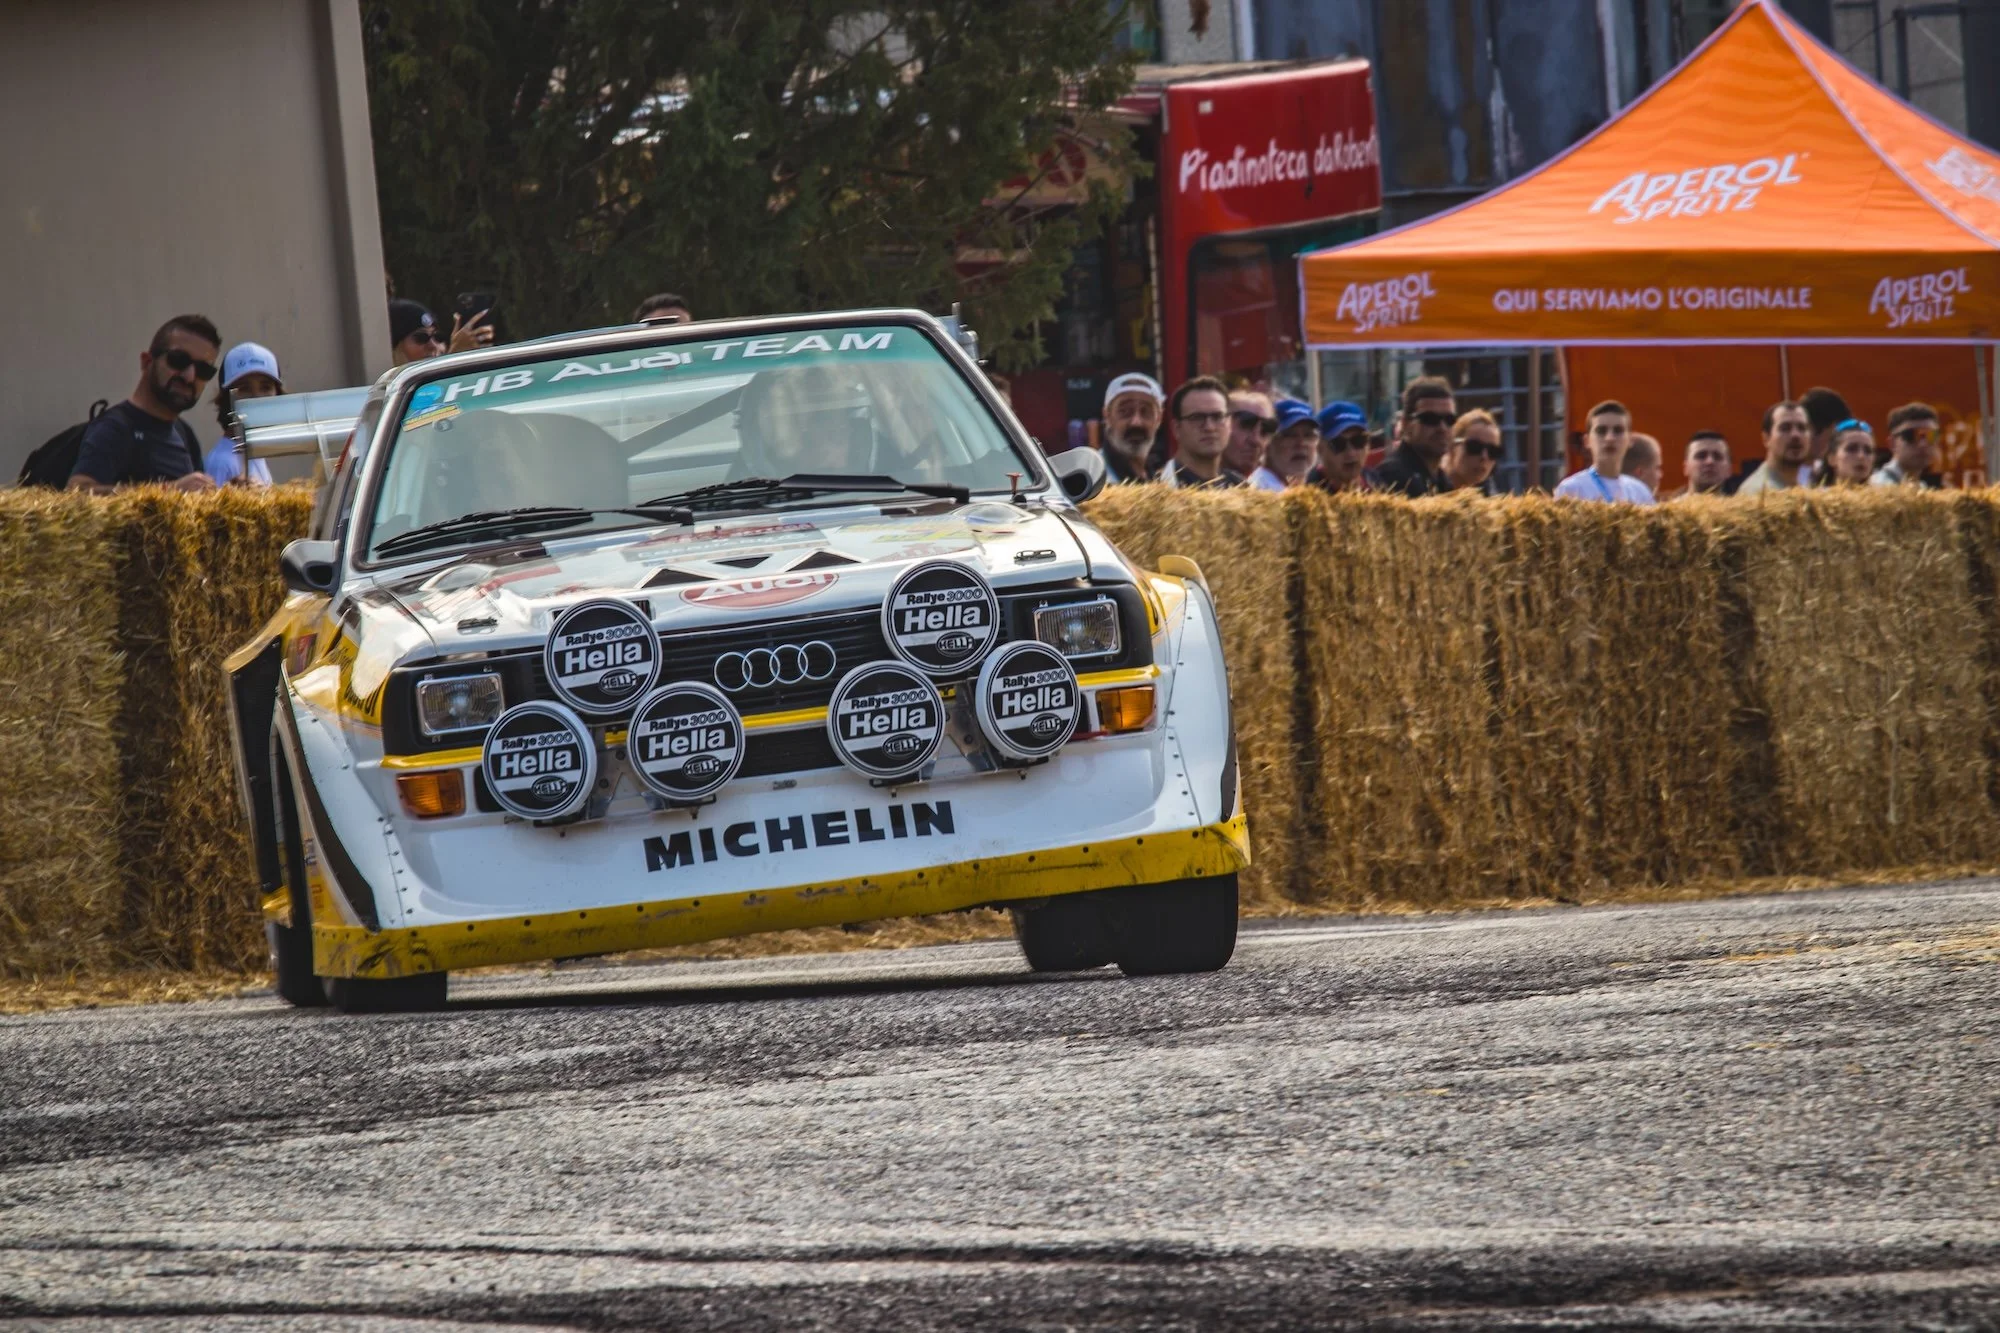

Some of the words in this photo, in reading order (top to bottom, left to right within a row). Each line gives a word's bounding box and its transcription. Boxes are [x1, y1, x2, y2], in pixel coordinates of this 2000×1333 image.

[1179, 137, 1309, 193] Piadinoteca
[1587, 152, 1803, 214] APEROL
[1612, 187, 1763, 224] SPRITZ
[1336, 271, 1437, 320] APEROL
[1493, 289, 1538, 313] QUI
[1543, 288, 1664, 312] SERVIAMO
[1667, 286, 1813, 310] L'ORIGINALE
[1868, 266, 1973, 315] APEROL
[1353, 298, 1420, 333] SPRITZ
[1886, 294, 1955, 329] SPRITZ
[443, 369, 535, 403] HB
[702, 332, 894, 361] TEAM
[906, 592, 945, 606] Rallye
[946, 587, 983, 601] 3000
[903, 605, 981, 633] Hella
[566, 631, 604, 647] Rallye
[605, 624, 643, 640] 3000
[564, 641, 642, 674] Hella
[1002, 676, 1036, 690] Rallye
[1036, 668, 1067, 684] 3000
[851, 696, 890, 711] Rallye
[891, 689, 928, 705] 3000
[1002, 686, 1067, 717] Hella
[650, 716, 689, 732] Rallye
[689, 710, 727, 726] 3000
[849, 706, 927, 738] Hella
[501, 737, 537, 751] Rallye
[537, 731, 573, 746] 3000
[648, 728, 726, 760] Hella
[499, 748, 572, 778] Hella
[643, 800, 955, 873] MICHELIN
